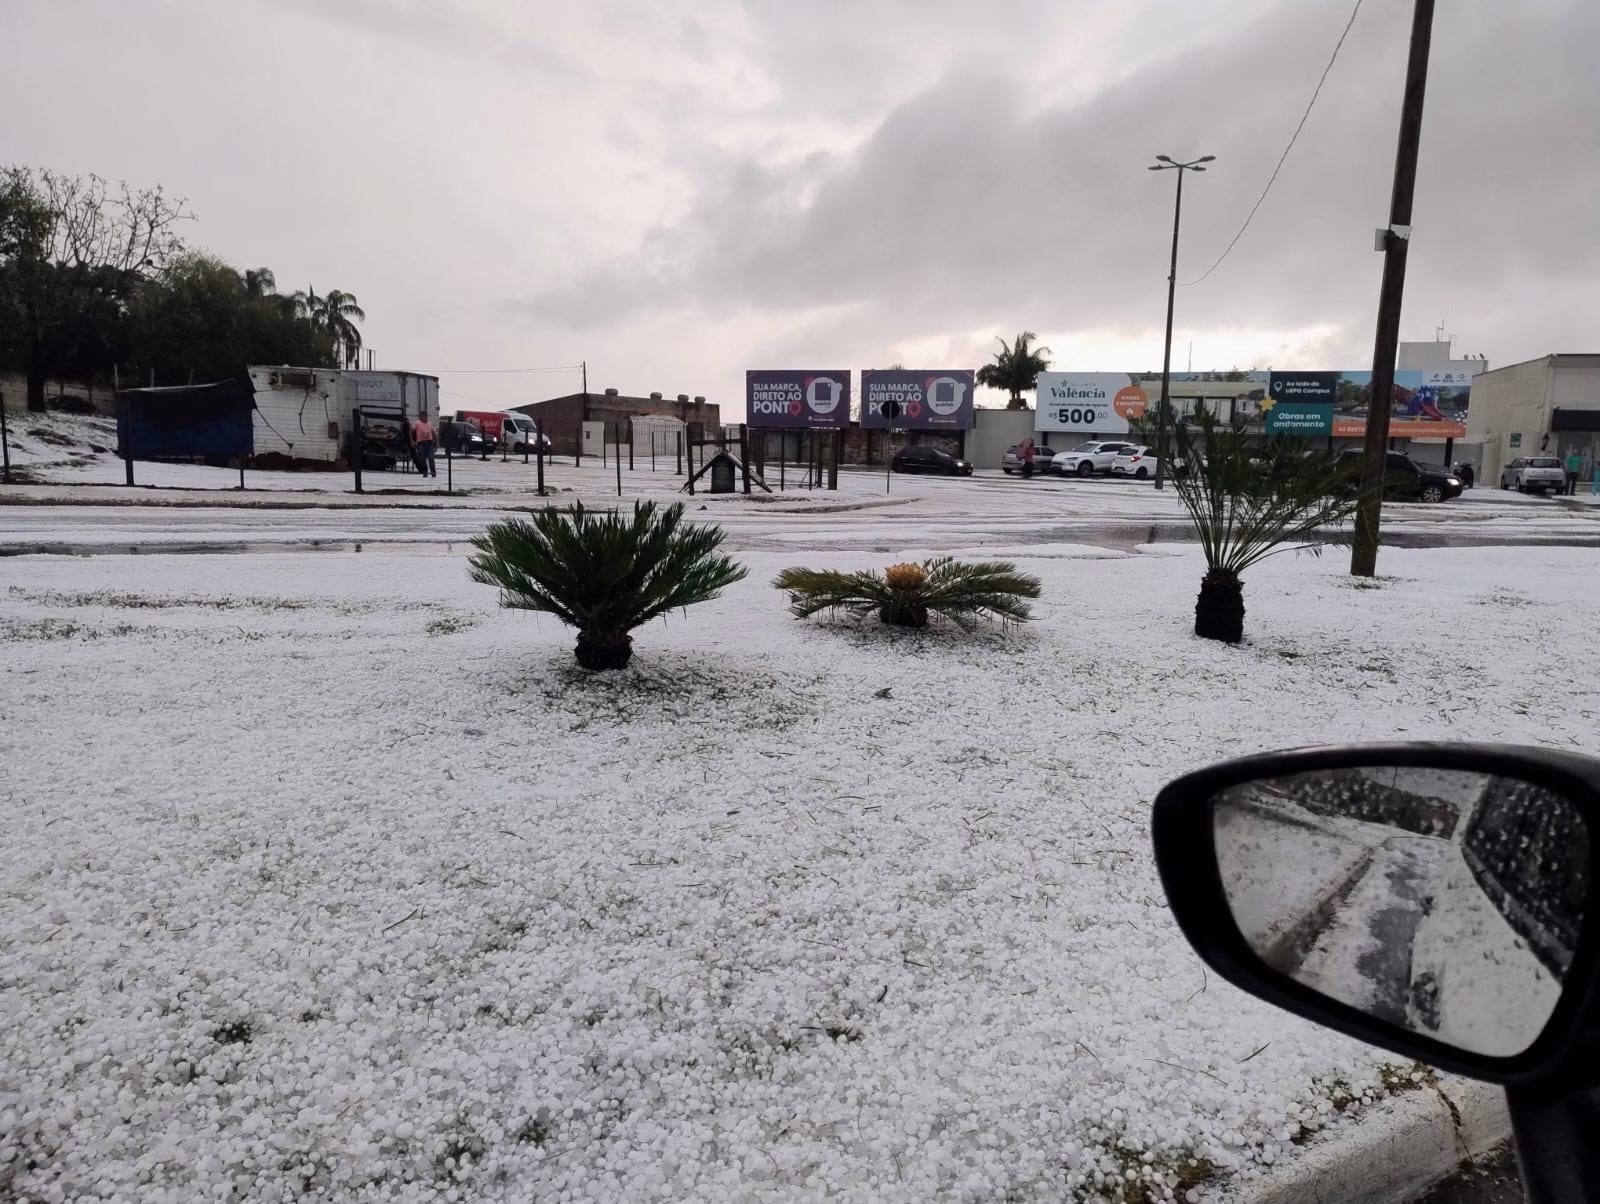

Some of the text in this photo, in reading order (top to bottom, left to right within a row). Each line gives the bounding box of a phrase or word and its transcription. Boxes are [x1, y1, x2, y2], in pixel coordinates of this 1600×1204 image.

[753, 383, 802, 392] SUA MARCA,
[869, 383, 922, 392] SUA MARCA,
[753, 392, 802, 400] DIRETO AO
[869, 392, 922, 401] DIRETO AO
[1050, 387, 1106, 398] Valência
[868, 401, 921, 416] PTO
[1278, 412, 1305, 420] Obras
[1273, 420, 1325, 428] andamento
